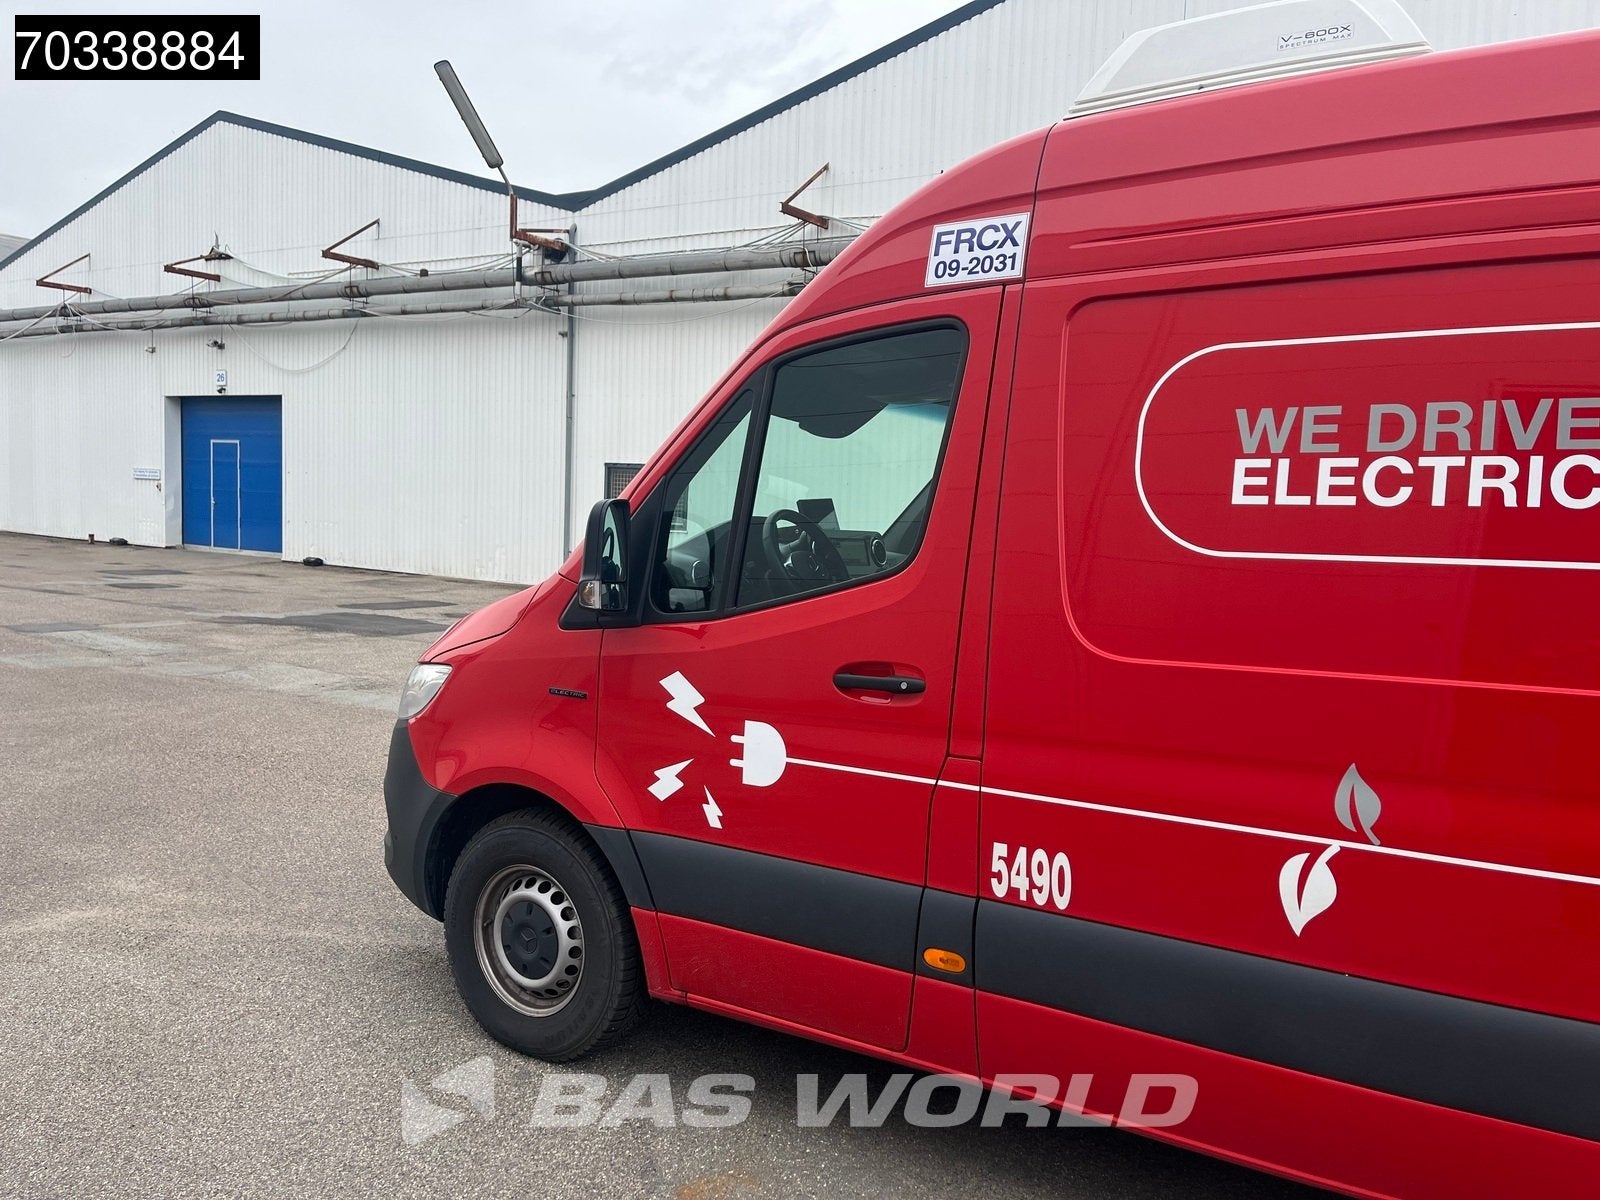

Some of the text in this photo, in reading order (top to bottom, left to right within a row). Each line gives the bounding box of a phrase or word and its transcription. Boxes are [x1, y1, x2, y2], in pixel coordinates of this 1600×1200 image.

[1279, 37, 1327, 49] SPECTRUM
[1281, 25, 1351, 42] V-600X
[933, 220, 1023, 257] FRCX
[934, 252, 1017, 279] 09-2031
[216, 373, 225, 383] 26
[1235, 398, 1600, 454] WE DRIVE
[1231, 455, 1600, 509] ELECTRIC
[550, 688, 585, 698] ELECTRIC
[990, 841, 1072, 910] 5490
